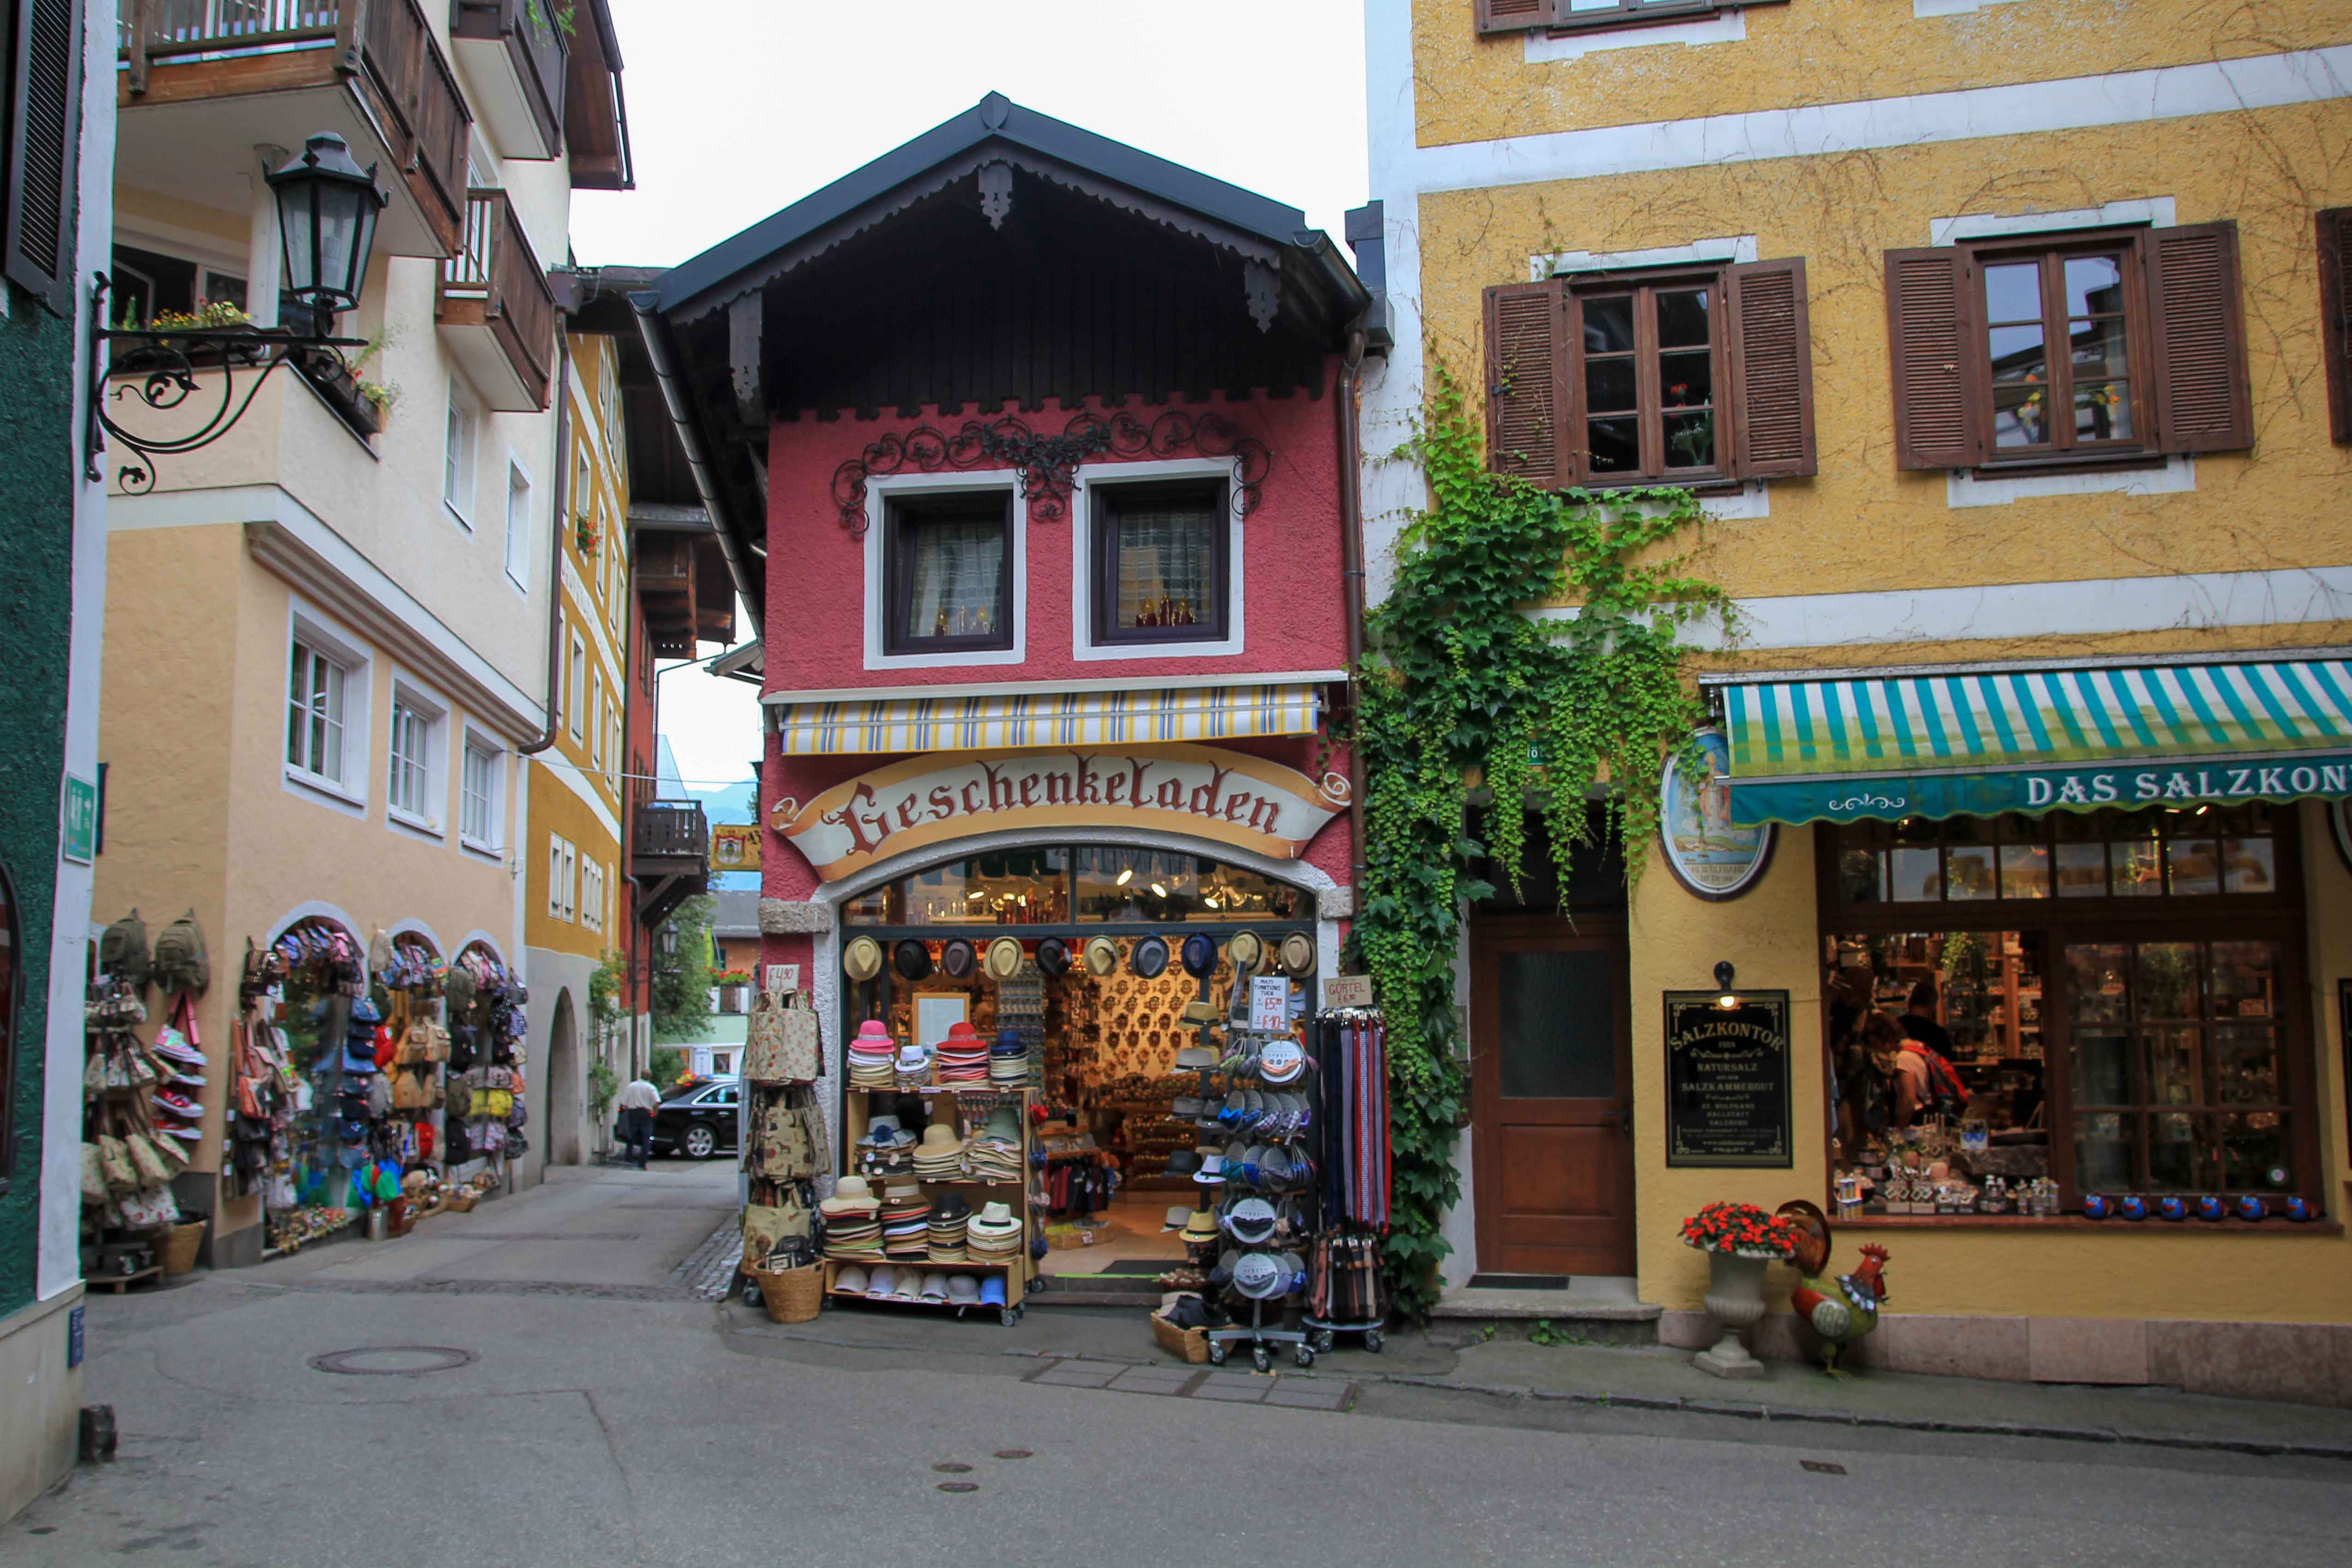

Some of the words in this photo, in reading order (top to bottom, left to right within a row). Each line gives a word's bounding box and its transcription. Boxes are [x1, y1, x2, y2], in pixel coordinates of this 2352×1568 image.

[2027, 775, 2118, 805] DAS
[2135, 764, 2352, 799] SALZKON
[820, 749, 1279, 856] Geschenkeladen
[1670, 1022, 1784, 1051] SALZKONTOR
[1697, 1063, 1758, 1072] NATURSALZ
[1681, 1082, 1774, 1092] SALZKAMMERGUT
